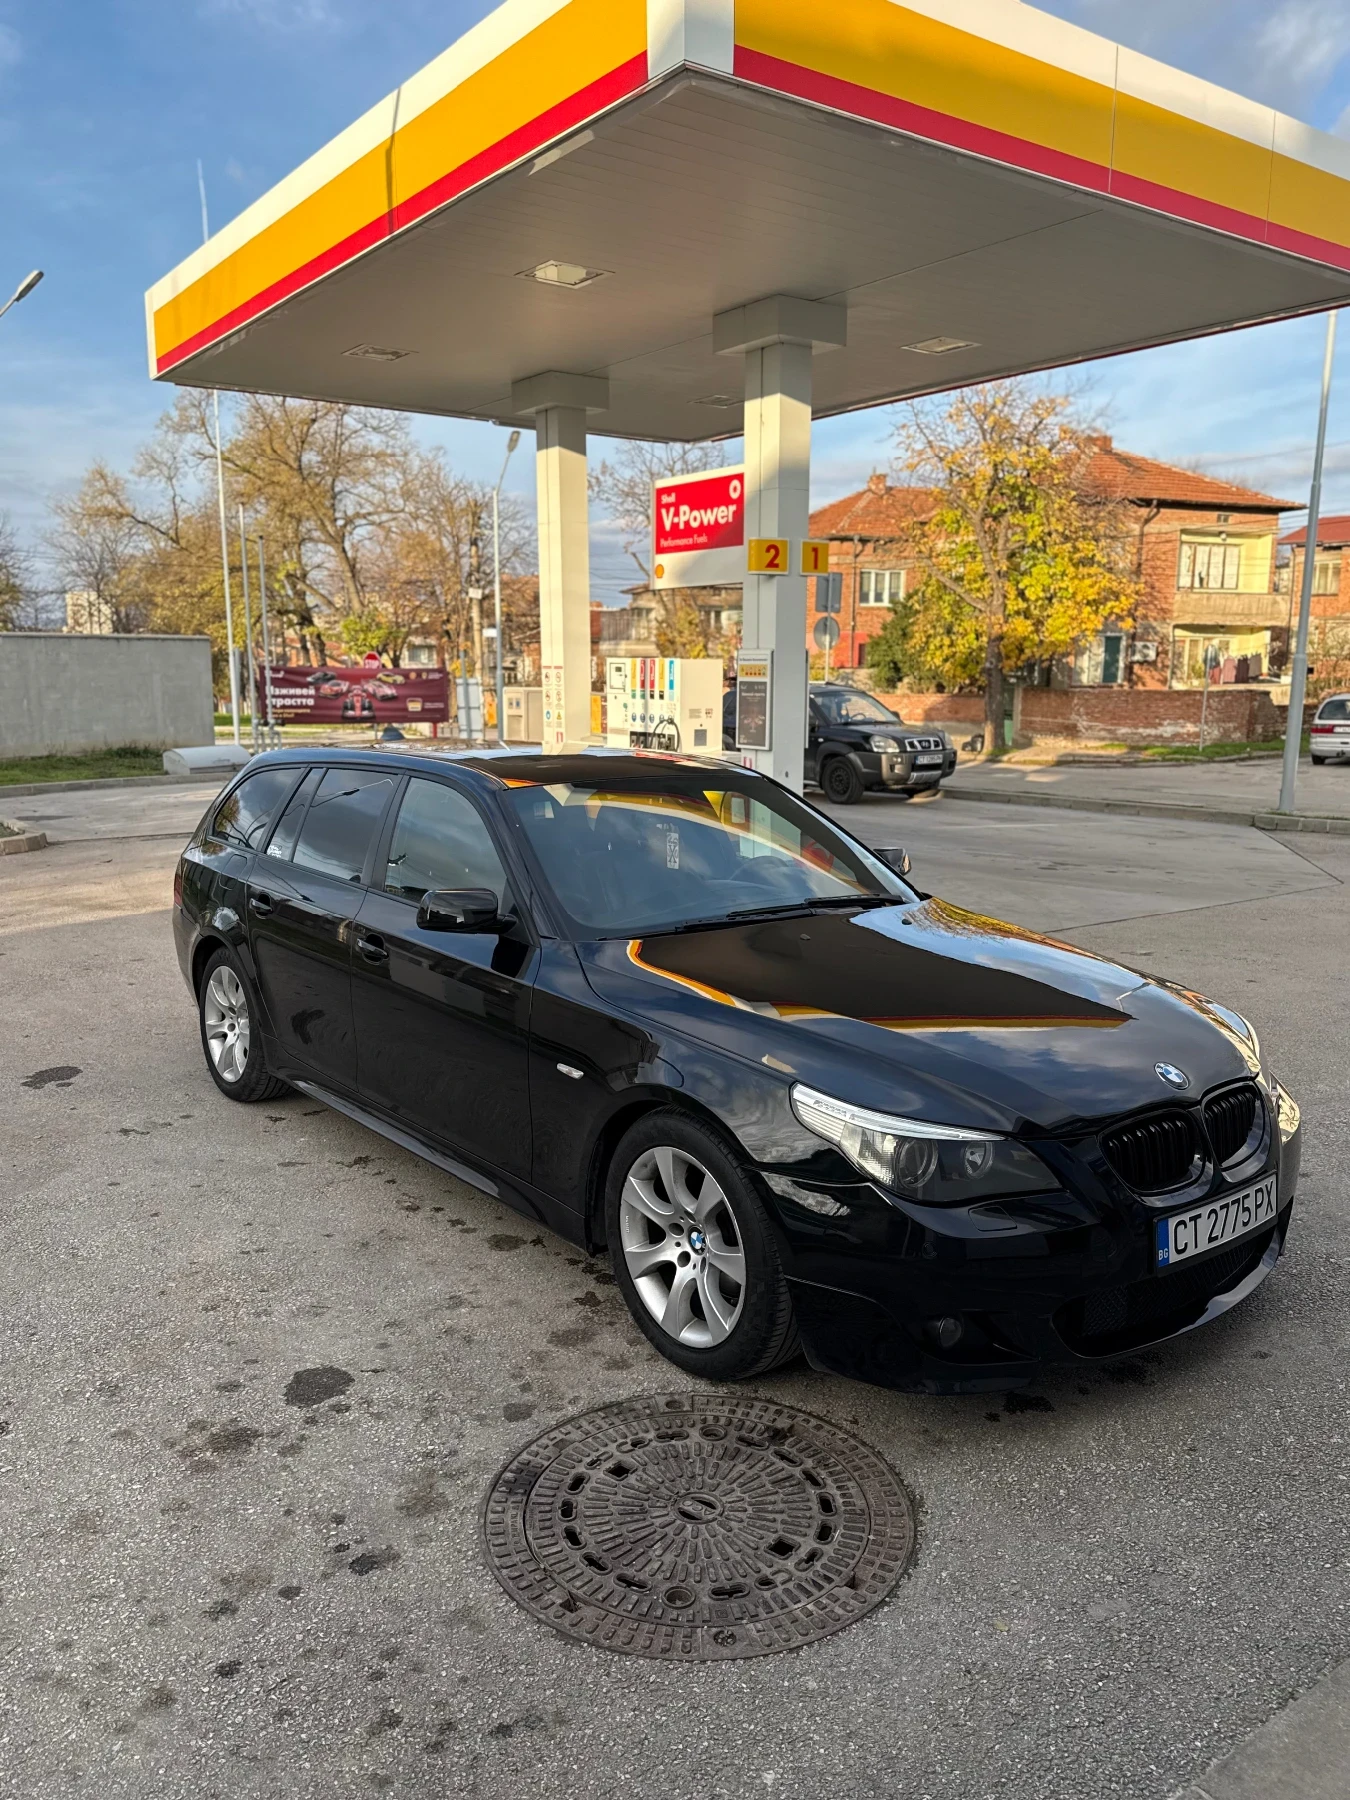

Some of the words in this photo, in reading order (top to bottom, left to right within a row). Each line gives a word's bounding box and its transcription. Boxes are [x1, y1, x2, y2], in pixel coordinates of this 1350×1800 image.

[661, 492, 676, 504] Shell
[661, 504, 736, 531] V-Power
[660, 536, 693, 548] Performance
[694, 533, 708, 545] Fuels
[765, 544, 780, 568] 2
[811, 546, 819, 570] 1
[365, 659, 380, 668] STOP
[1174, 1212, 1207, 1255] CT
[1207, 1193, 1251, 1244] 2775
[1254, 1180, 1274, 1222] PX
[1158, 1248, 1169, 1260] BG
